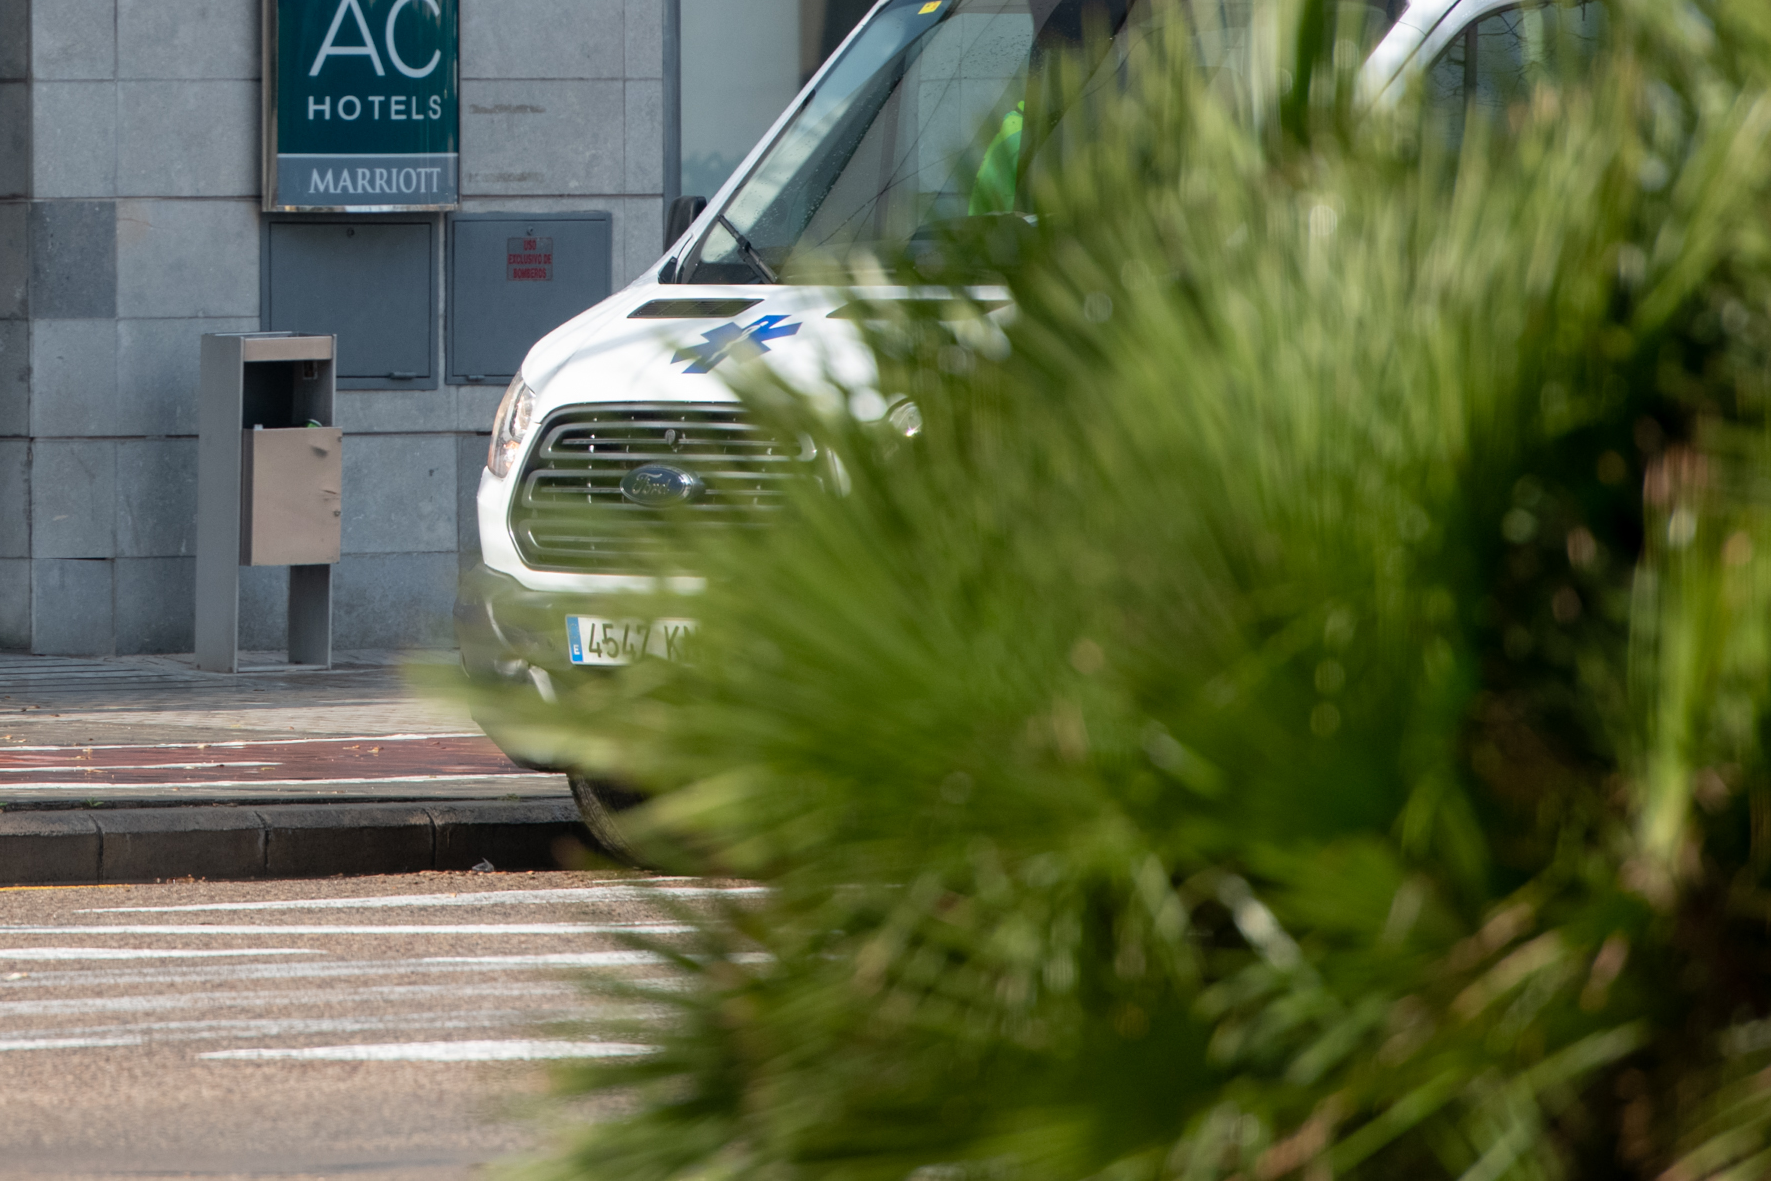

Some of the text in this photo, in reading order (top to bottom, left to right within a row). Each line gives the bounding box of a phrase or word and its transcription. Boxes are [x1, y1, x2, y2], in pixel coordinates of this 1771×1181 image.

[308, 95, 441, 120] HOTELS
[309, 168, 441, 194] MARRIOTT
[523, 239, 537, 251] USO
[508, 253, 552, 265] EXCLUSIVO DE
[513, 267, 547, 279] BOMBEROS
[632, 472, 671, 495] Ford
[573, 644, 581, 655] E
[589, 623, 651, 661] 4547
